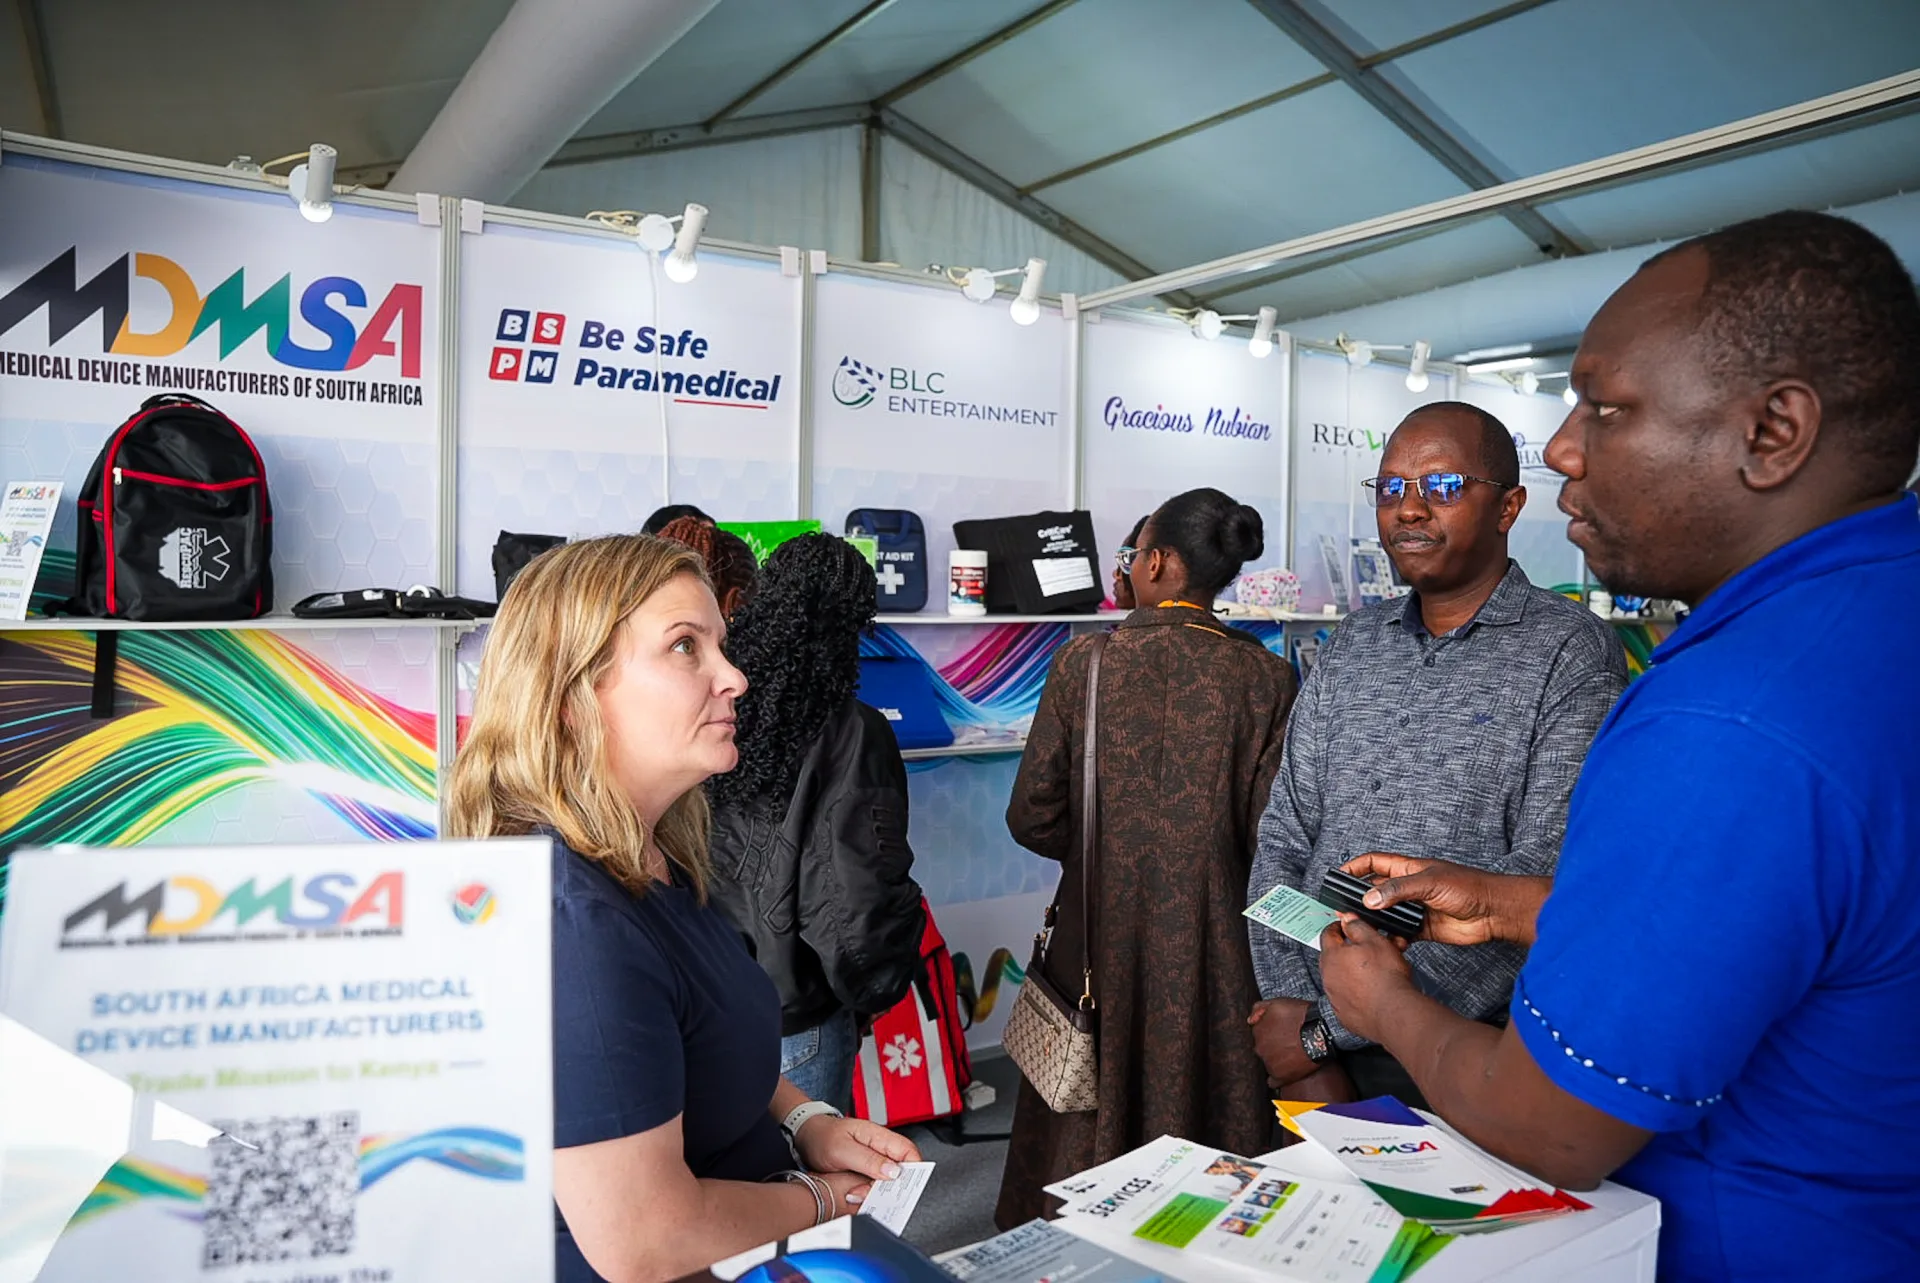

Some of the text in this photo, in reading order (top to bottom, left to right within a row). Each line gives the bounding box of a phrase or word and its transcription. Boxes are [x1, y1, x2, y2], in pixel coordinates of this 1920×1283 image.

[0, 245, 423, 379] MDMSA
[503, 313, 558, 339] B S
[579, 320, 709, 360] Be Safe
[78, 358, 141, 386] DEVICE
[145, 364, 290, 397] MANUFACTURERS
[293, 376, 313, 399] OF
[315, 377, 367, 402] SOUTH
[370, 382, 423, 406] AFRICA
[496, 353, 555, 378] P M
[573, 357, 781, 402] Paramedical
[889, 366, 945, 395] BLC
[888, 395, 1059, 427] ENTERTAINMENT
[1104, 395, 1272, 441] Gracious Nubian
[885, 551, 900, 561] AID
[901, 551, 915, 561] KIT
[62, 870, 406, 935] MDMSA
[90, 977, 474, 1018] SOUTH AFRICA MEDICAL
[75, 1009, 486, 1054] DEVICE MANUFACTURERS
[1337, 1140, 1439, 1155] MDMSA
[1089, 1177, 1153, 1217] SERVICES
